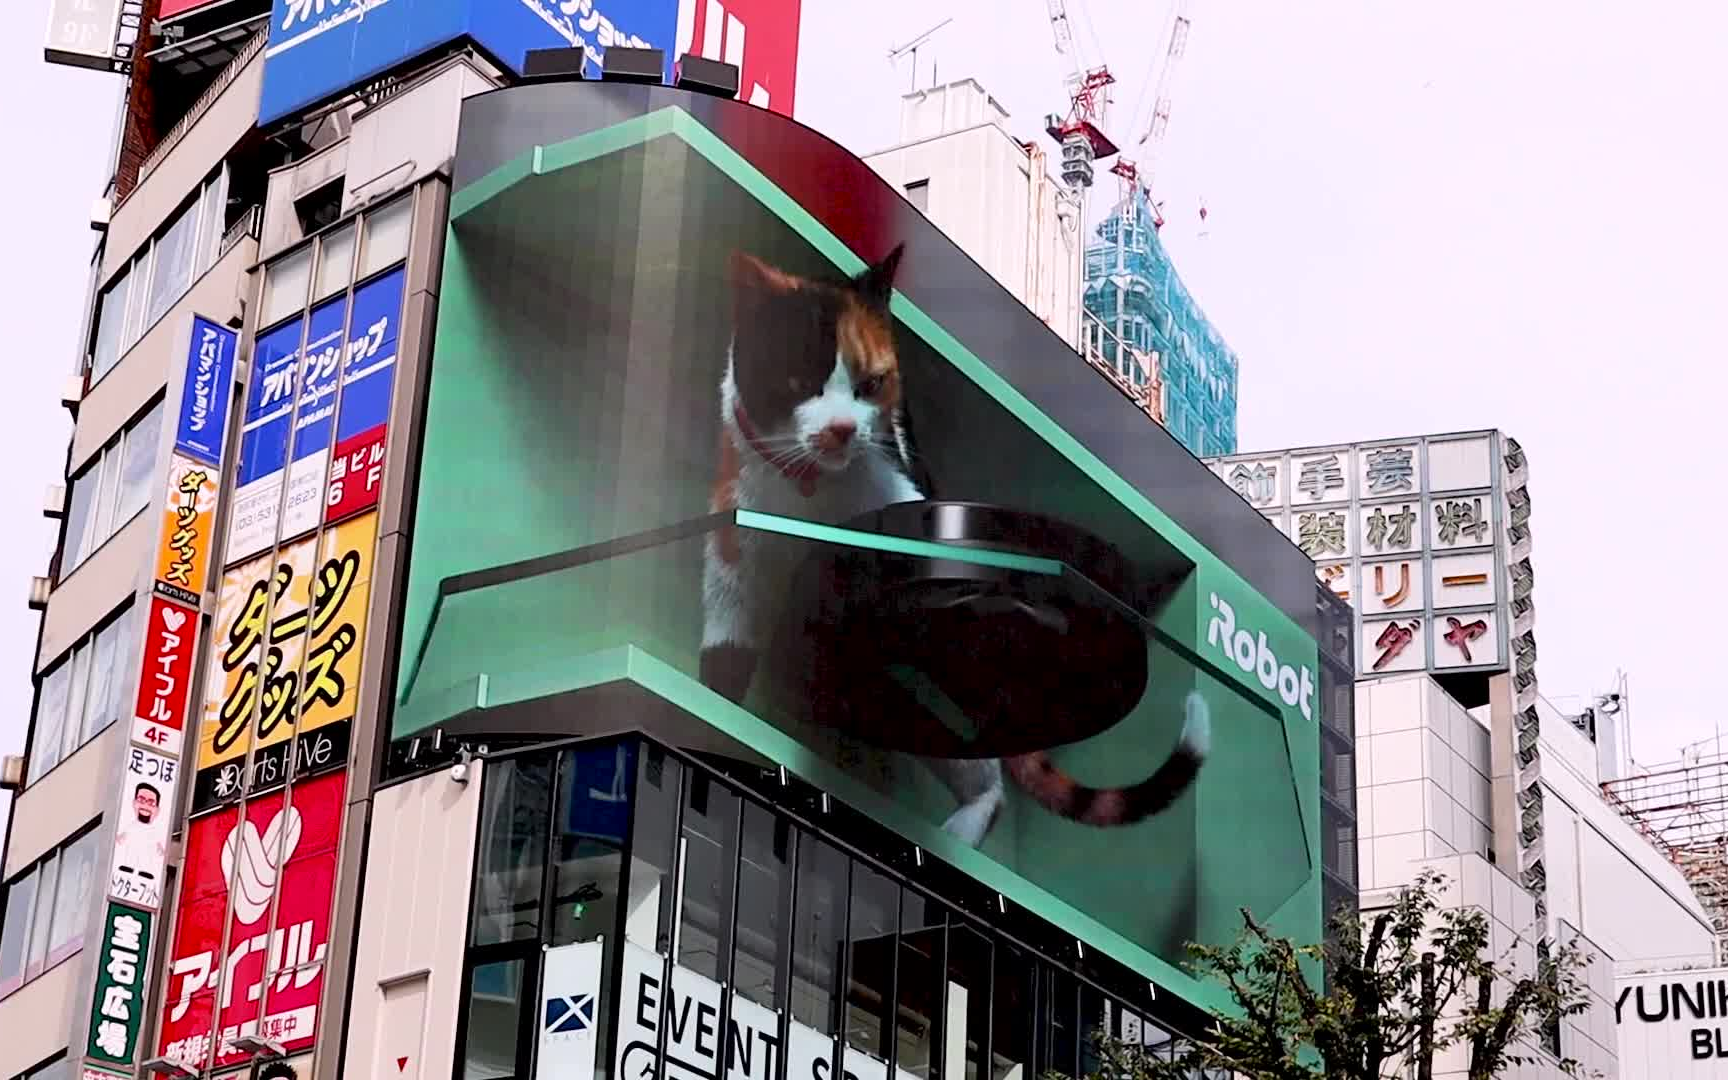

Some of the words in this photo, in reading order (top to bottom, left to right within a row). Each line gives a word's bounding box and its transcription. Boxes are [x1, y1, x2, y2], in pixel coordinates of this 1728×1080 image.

[331, 441, 385, 481] 当ビル
[1230, 449, 1414, 505] 飾手芸
[165, 471, 207, 586] ダーツグッズ
[1299, 498, 1488, 556] 装材料
[223, 550, 360, 672] ダーツ
[1208, 592, 1315, 720] iRobot
[1372, 617, 1488, 671] ダヤ
[149, 631, 181, 722] アイフル
[213, 623, 357, 755] グッズ
[144, 726, 170, 746] 4F
[96, 915, 142, 1058] 宝石広場
[170, 920, 328, 1023] アイフル
[637, 972, 779, 1080] EVENT
